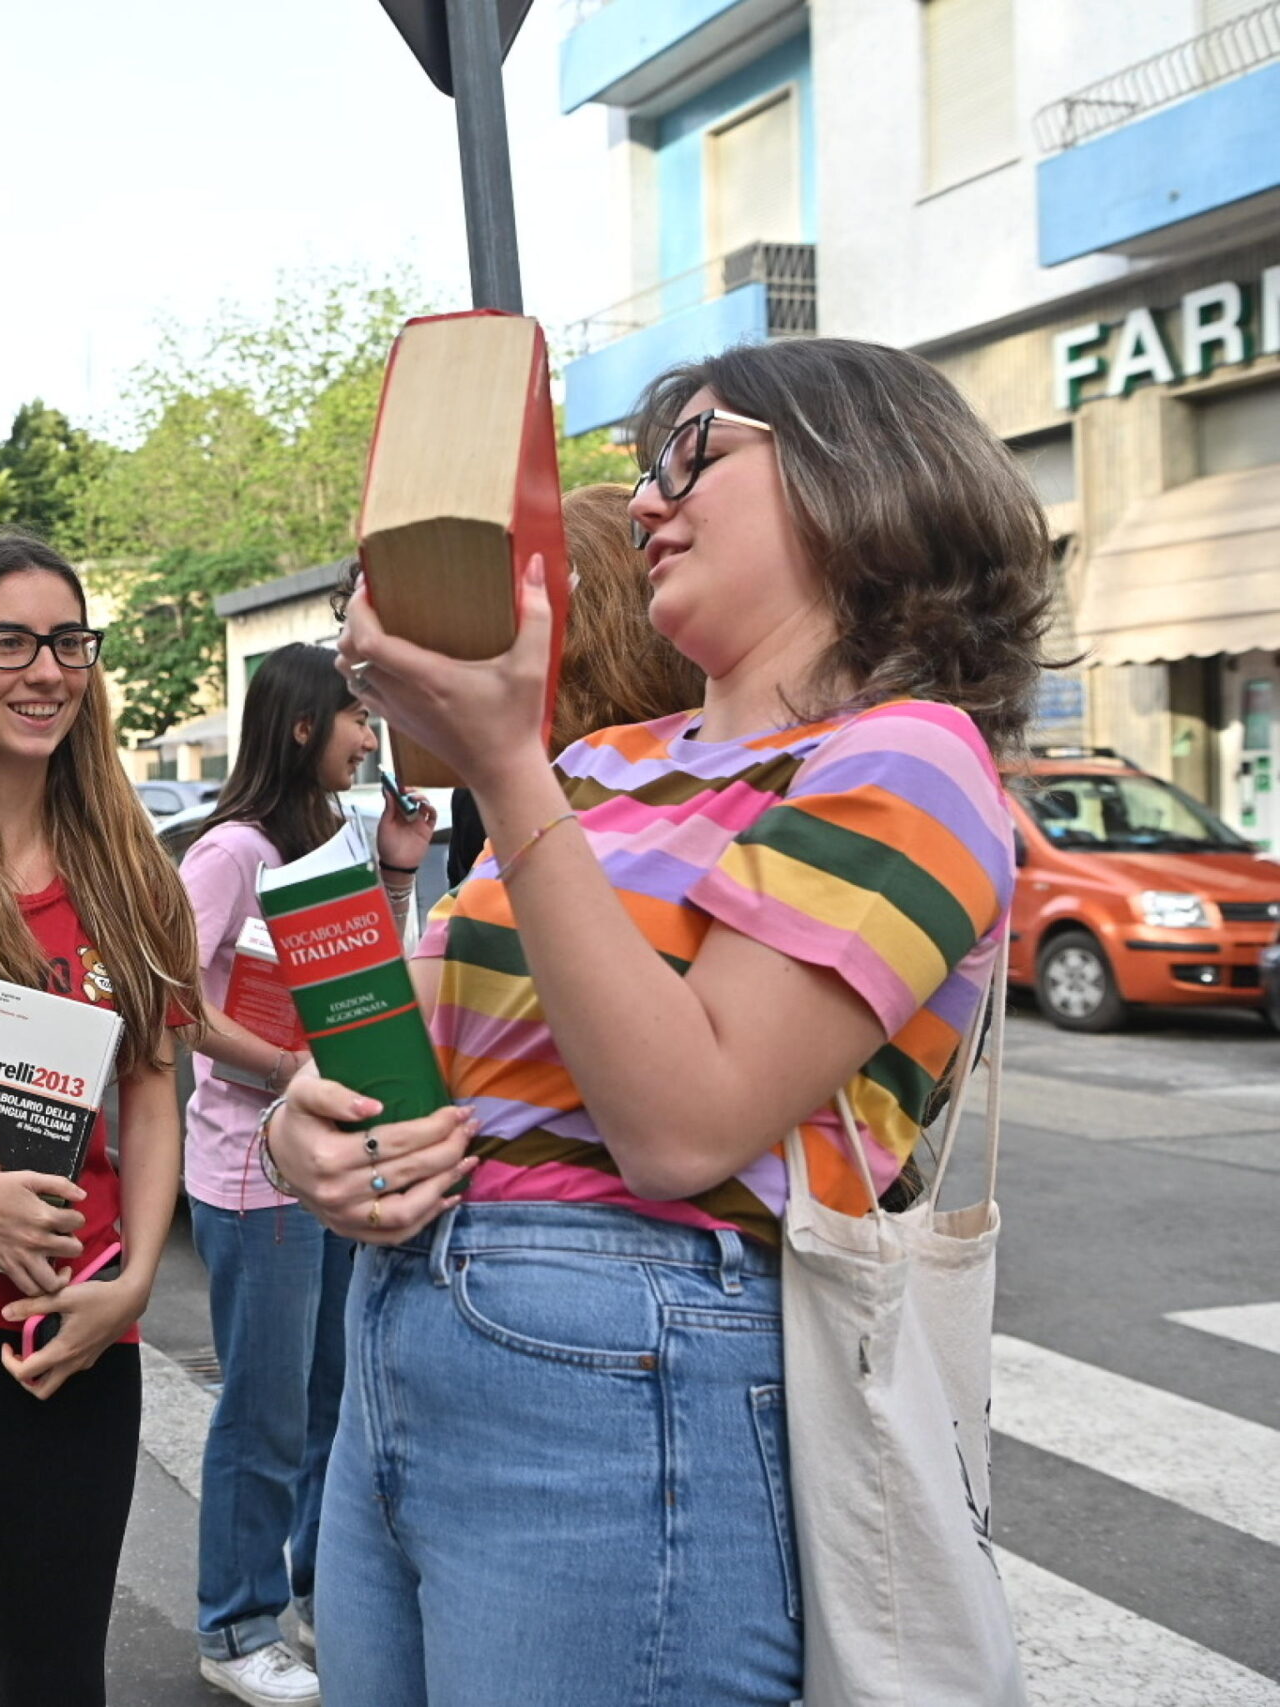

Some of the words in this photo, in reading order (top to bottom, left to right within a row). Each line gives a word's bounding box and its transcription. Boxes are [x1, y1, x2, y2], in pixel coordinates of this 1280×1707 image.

[279, 911, 380, 950] VOCABOLARIO
[289, 928, 380, 967] ITALIANO
[325, 1000, 389, 1024] AGGIORNATA
[329, 992, 375, 1013] EDIZIONE
[29, 1113, 74, 1134] ITALIANA
[45, 1105, 77, 1122] DELLA
